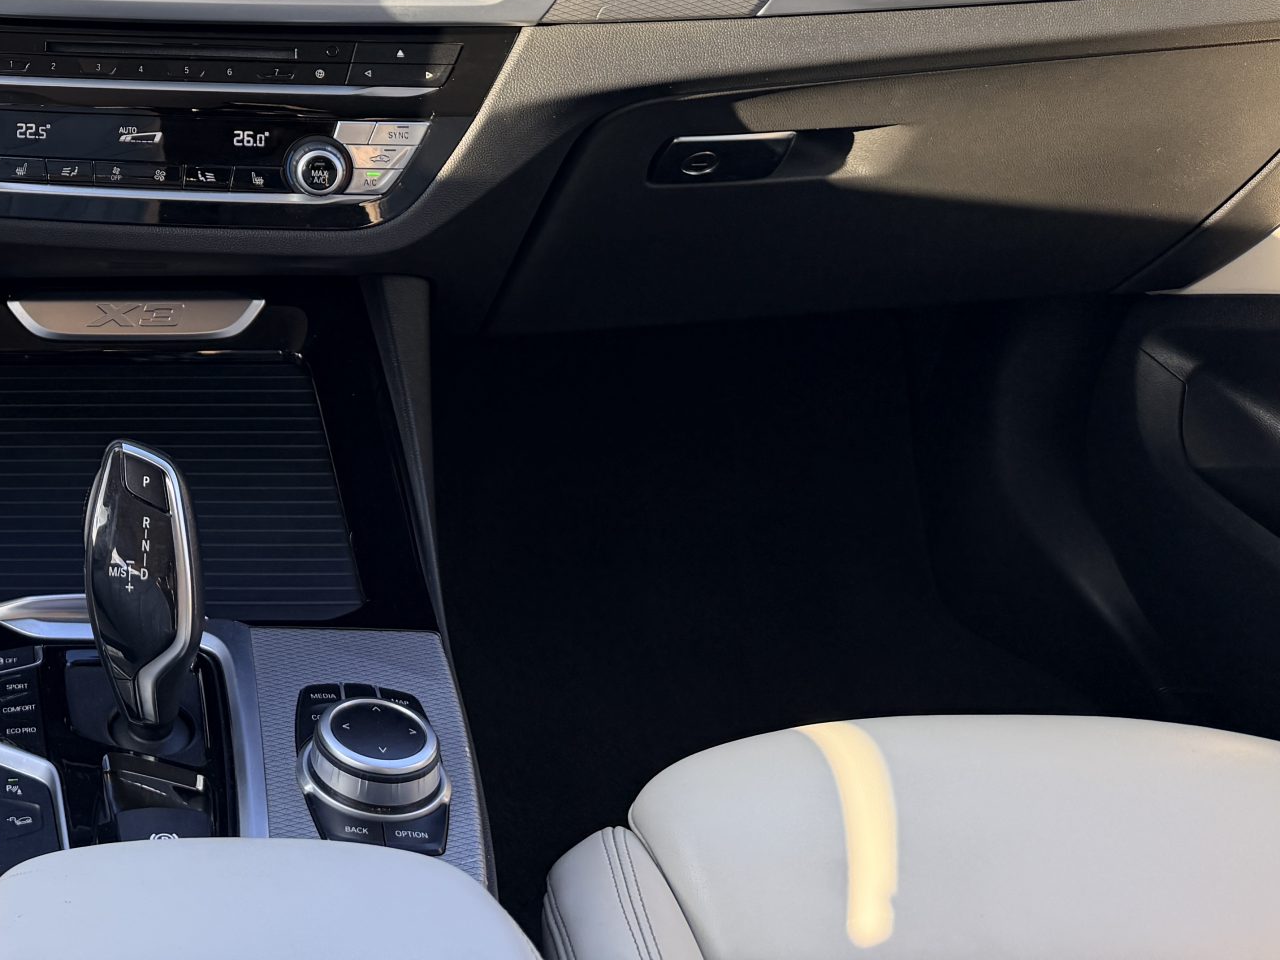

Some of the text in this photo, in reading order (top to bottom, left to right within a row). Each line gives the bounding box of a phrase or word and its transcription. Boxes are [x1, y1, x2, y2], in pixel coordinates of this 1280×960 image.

[118, 126, 137, 134] AUTO
[388, 131, 409, 140] SYNC
[311, 169, 328, 177] MAX
[313, 176, 326, 184] A/C
[86, 303, 184, 328] X3
[142, 475, 150, 488] P
[142, 516, 151, 529] R
[141, 539, 150, 552] N
[108, 566, 127, 578] M/S
[140, 567, 149, 580] D
[310, 692, 337, 700] MEDIA
[2, 704, 36, 714] COMFORT
[6, 726, 37, 735] ECO PRO
[344, 825, 369, 835] BACK
[394, 829, 429, 839] OPTION
